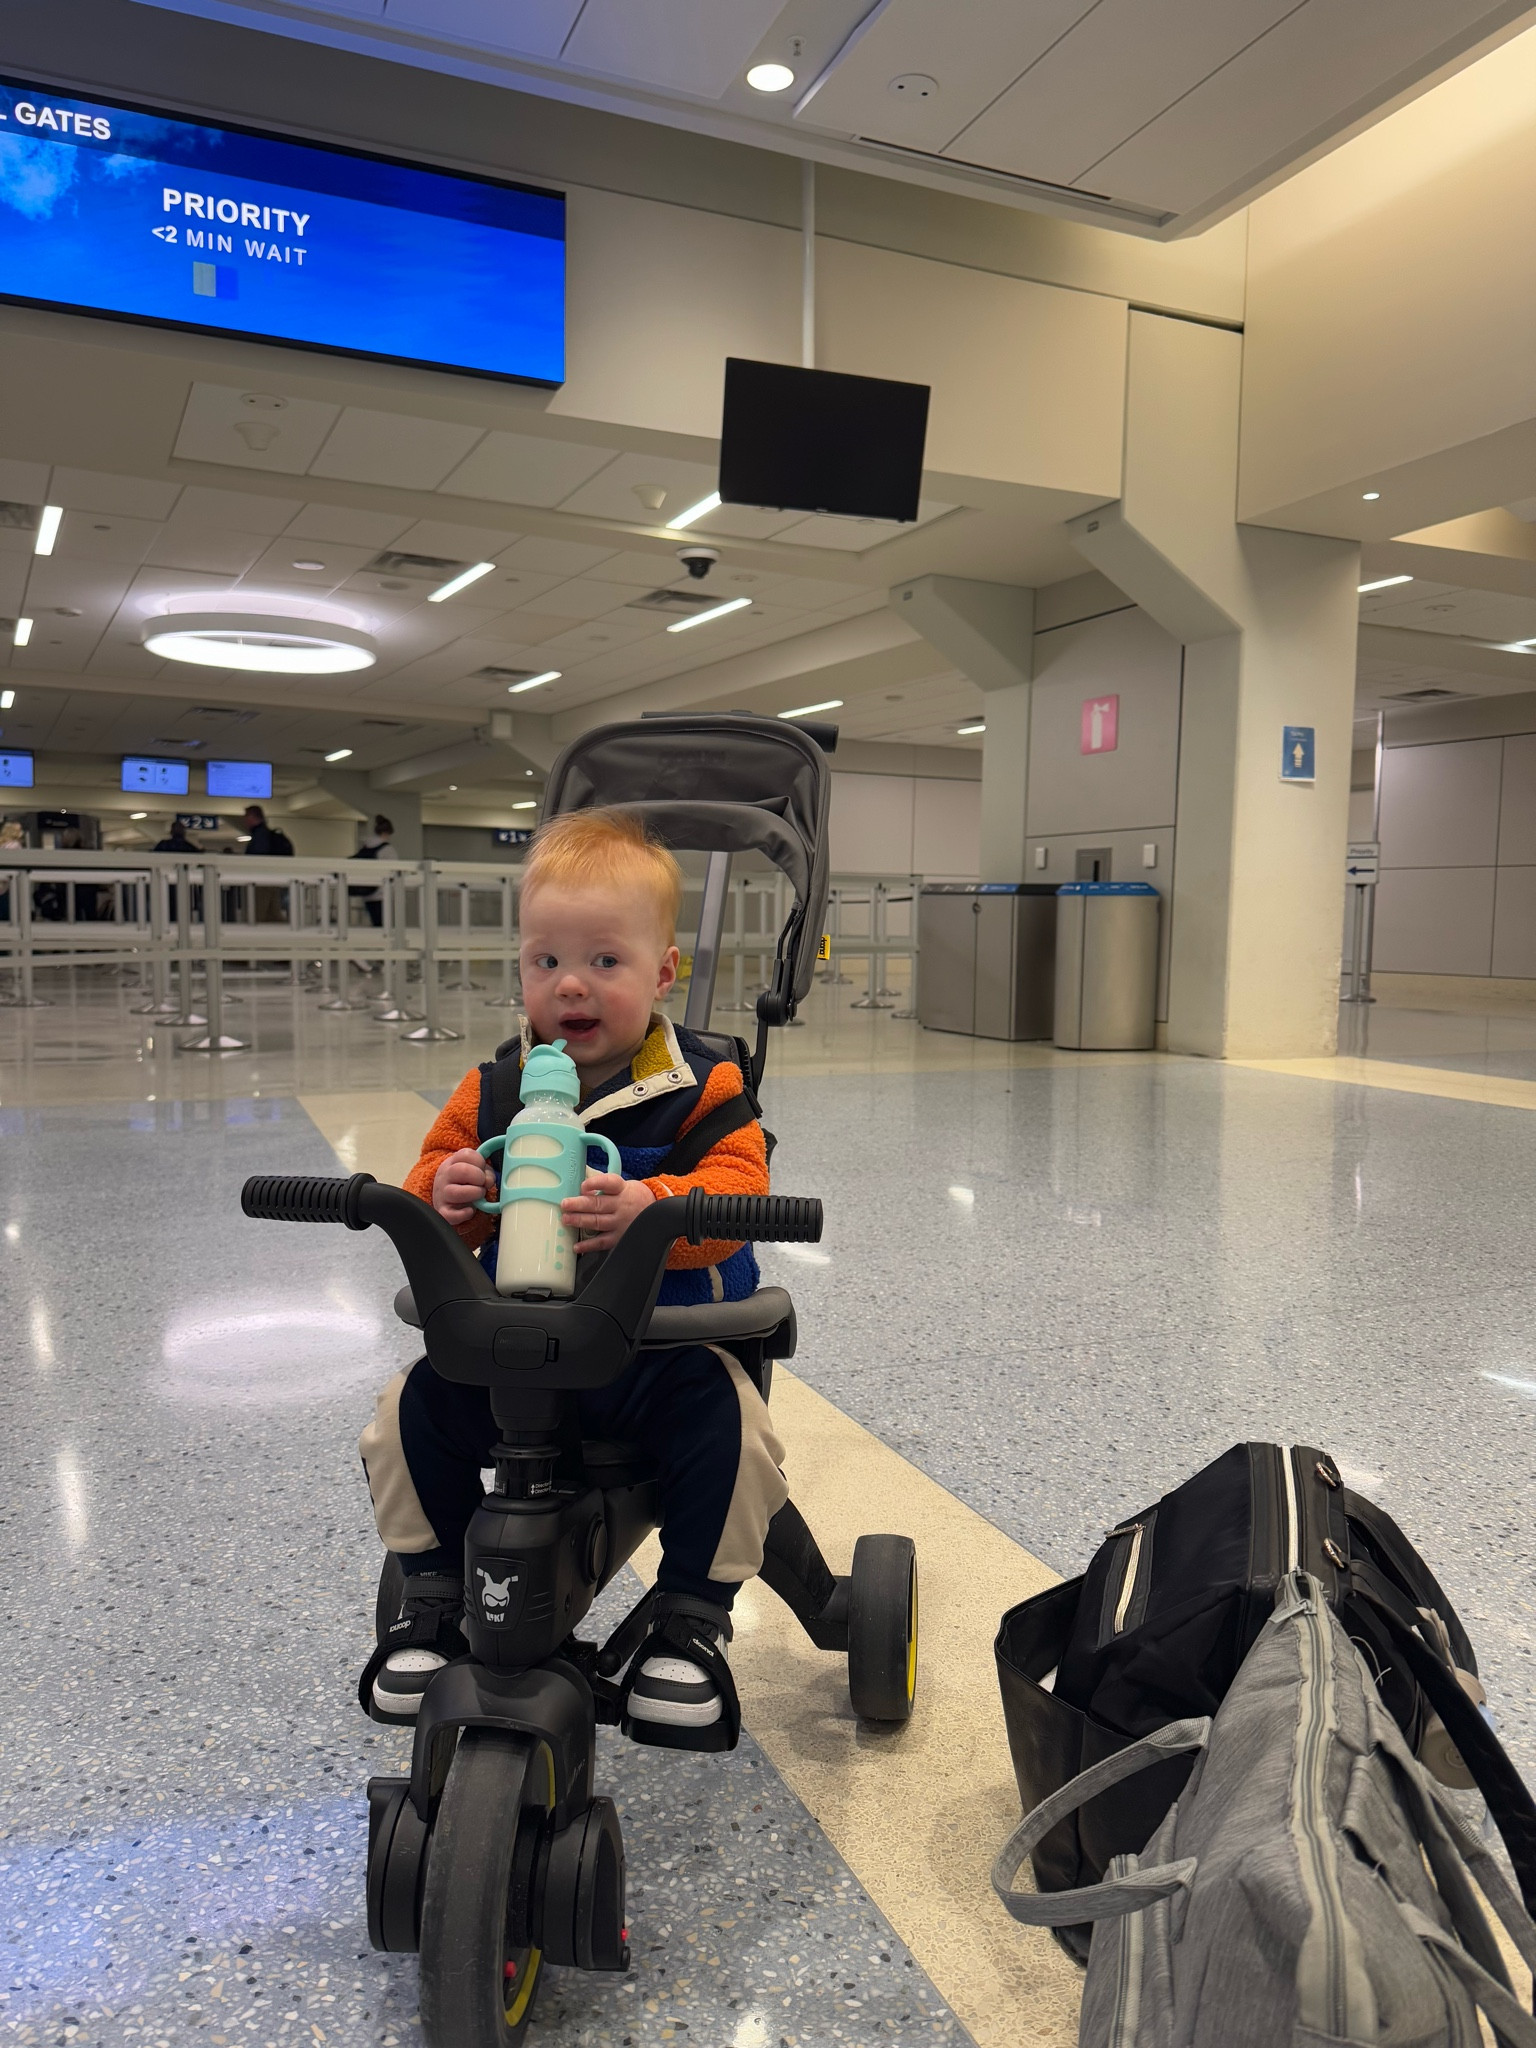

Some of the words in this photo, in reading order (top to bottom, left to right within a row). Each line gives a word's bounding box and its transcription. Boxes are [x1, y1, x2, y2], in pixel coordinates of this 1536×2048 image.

[14, 101, 111, 141] GATES
[162, 187, 311, 237] PRIORITY
[151, 225, 178, 244] <2
[186, 228, 232, 254] MIN
[244, 238, 308, 266] WAIT
[191, 815, 202, 829] 2
[389, 1620, 411, 1633] doona
[692, 1638, 715, 1658] doona
